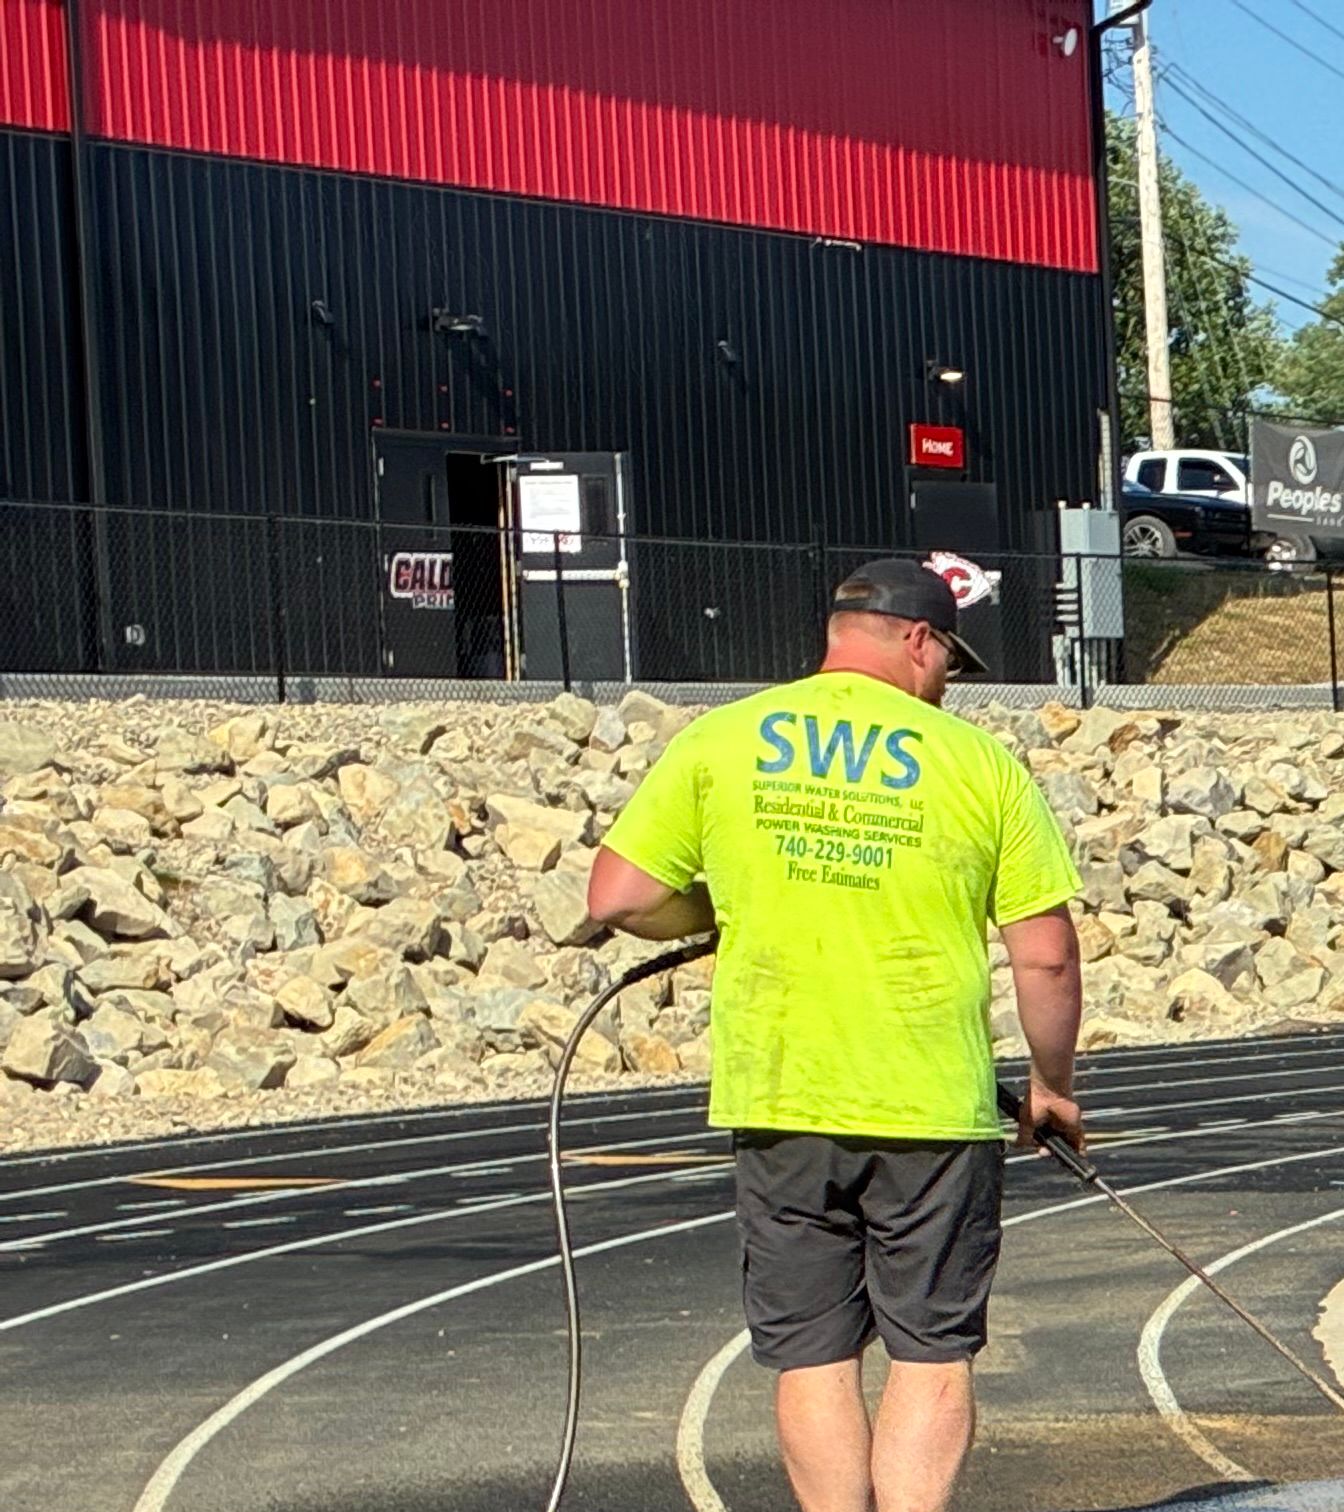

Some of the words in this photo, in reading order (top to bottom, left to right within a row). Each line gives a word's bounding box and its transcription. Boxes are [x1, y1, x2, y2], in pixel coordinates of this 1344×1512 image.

[921, 437, 954, 456] HOME
[1266, 480, 1342, 515] Peoples
[756, 711, 924, 790] SWS
[752, 780, 801, 793] SUPERIOR
[804, 784, 840, 799] WATER
[754, 794, 826, 820] Residential
[828, 803, 839, 822] &
[844, 804, 925, 833] Commercial
[756, 818, 801, 831] POWER
[804, 822, 860, 840] WASHING
[863, 830, 922, 848] SERVICES
[775, 834, 893, 869] 740-229-9001
[787, 860, 818, 882] Free
[821, 864, 880, 891] Estimates
